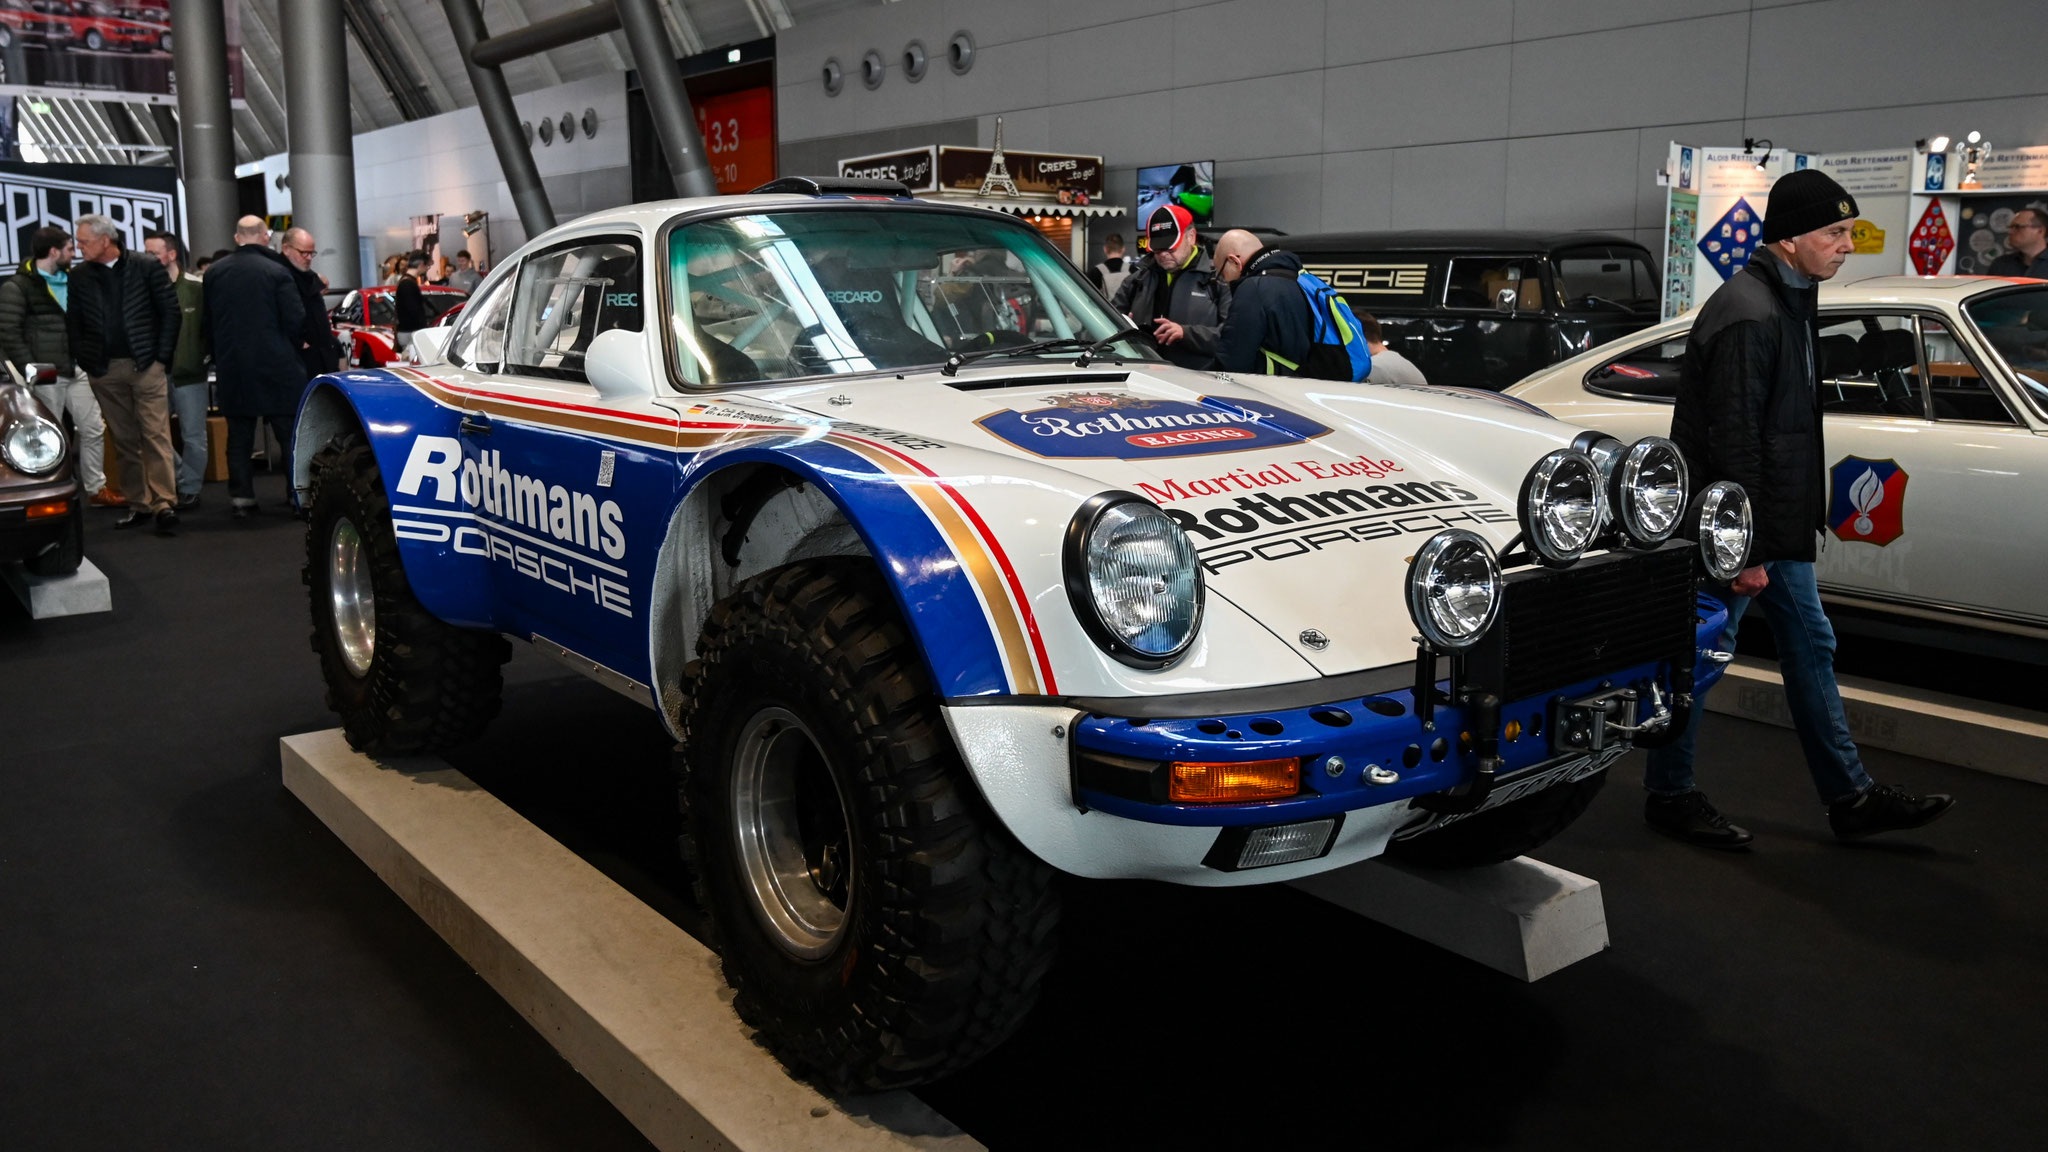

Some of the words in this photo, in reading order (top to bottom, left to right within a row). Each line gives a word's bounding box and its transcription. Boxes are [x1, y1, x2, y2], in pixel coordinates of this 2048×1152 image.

[711, 118, 739, 153] 3.3
[725, 163, 738, 182] 10
[1039, 160, 1078, 173] CREPES
[826, 290, 883, 303] RECARO
[1020, 405, 1275, 438] Rothmans
[1139, 428, 1245, 447] RACING
[1133, 459, 1301, 504] Martial
[1291, 455, 1405, 480] Eagle
[396, 434, 626, 560] Rothmans
[1199, 508, 1519, 576] PORSCHE
[392, 518, 633, 618] PORSCHE
